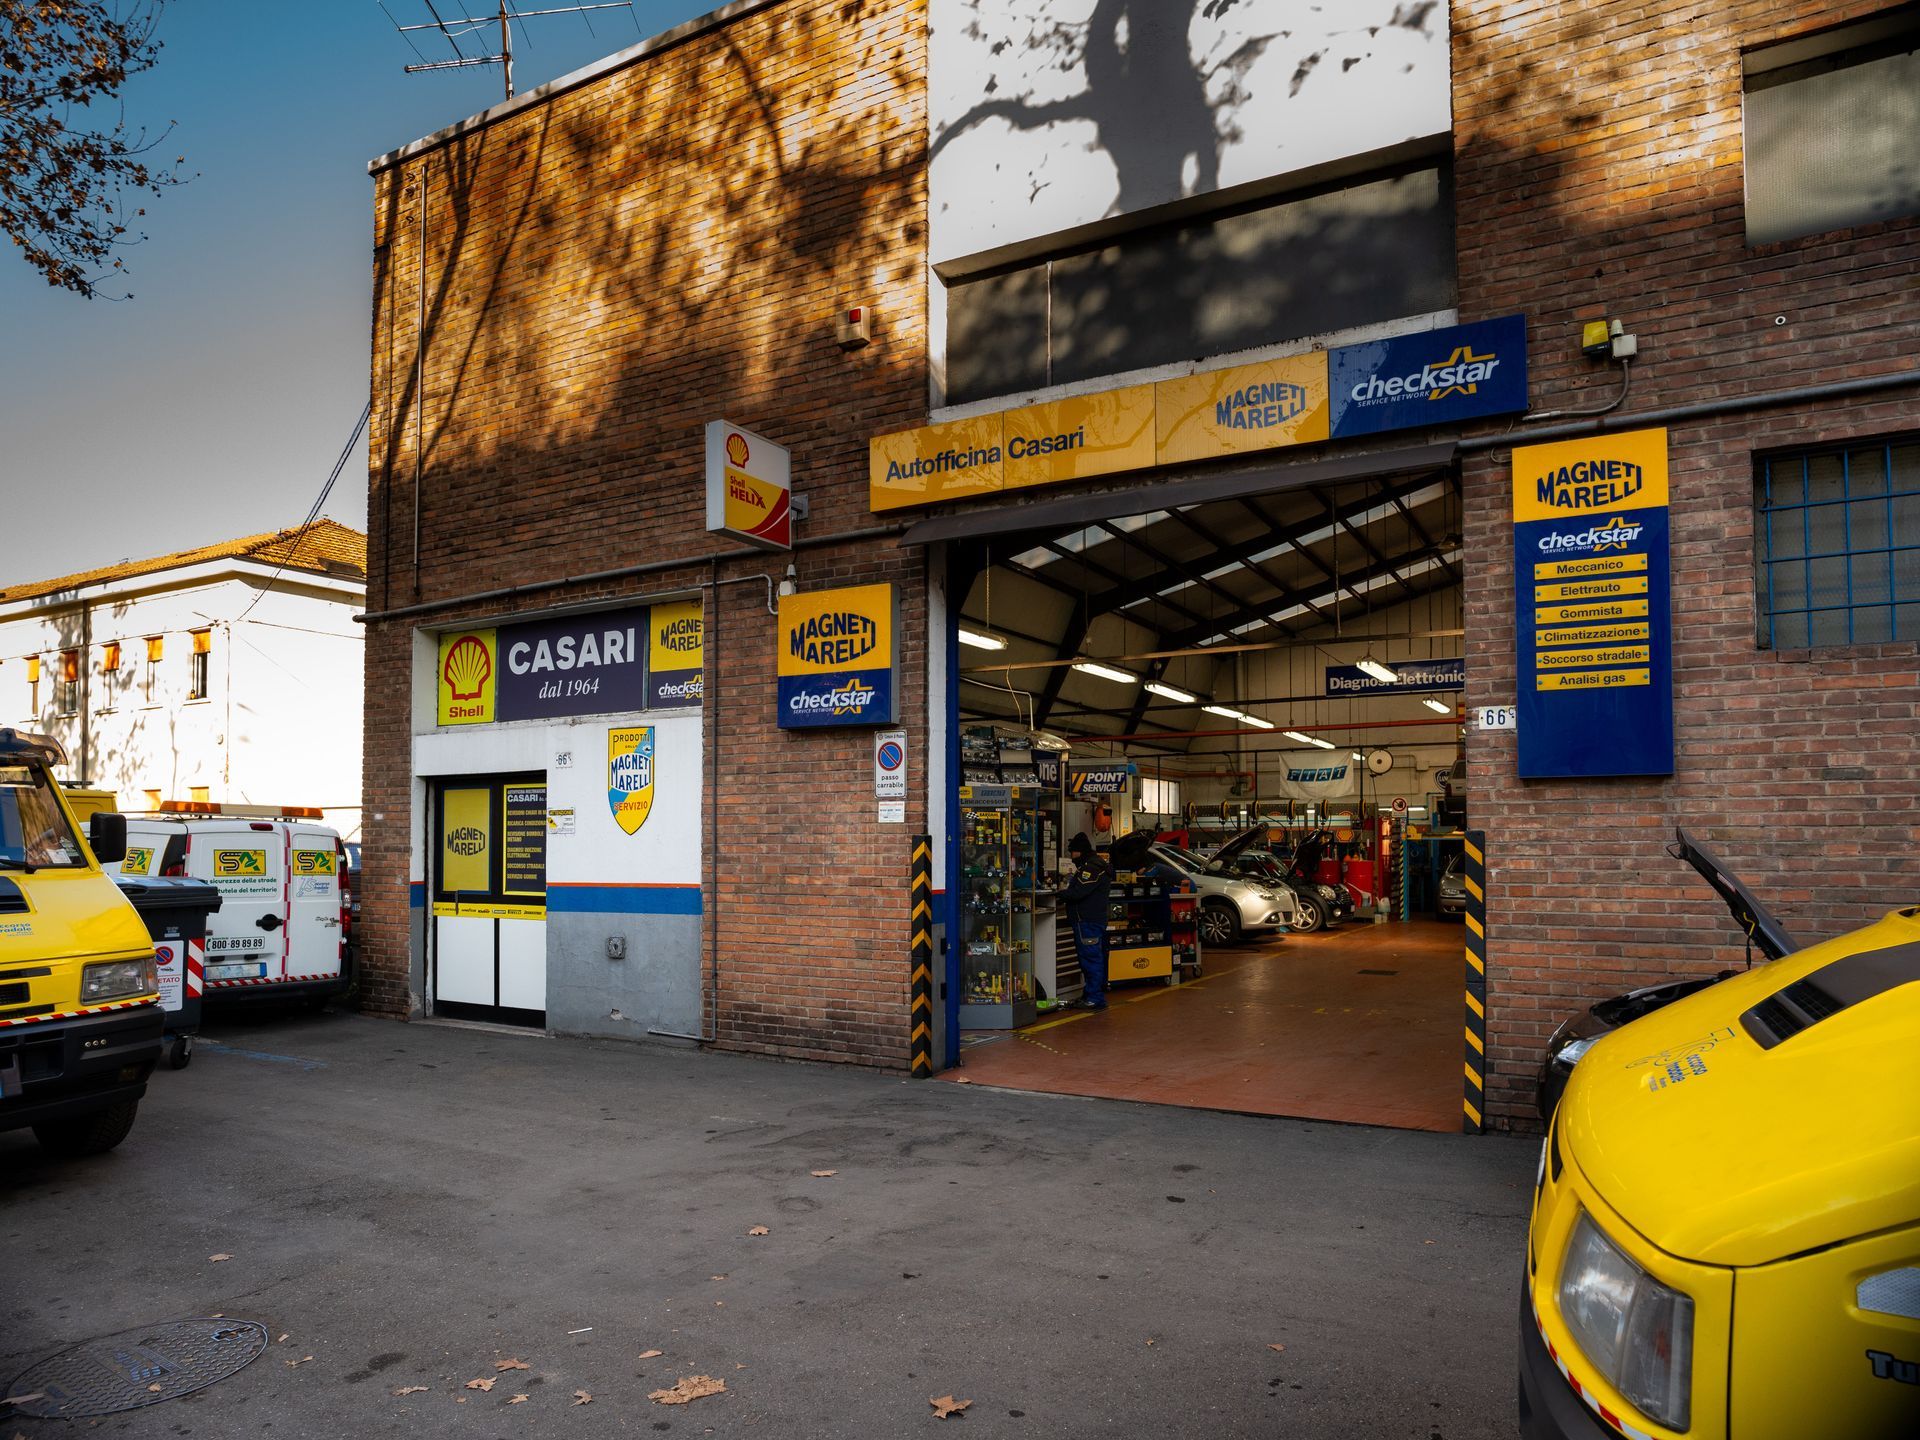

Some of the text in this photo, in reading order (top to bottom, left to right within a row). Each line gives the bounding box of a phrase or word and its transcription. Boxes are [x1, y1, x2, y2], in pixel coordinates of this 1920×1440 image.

[1351, 360, 1500, 401] checkstar
[1216, 383, 1306, 411] MAGNETI
[1357, 390, 1430, 408] SERVICE NETWORK
[1216, 400, 1306, 429] MARELLI
[885, 426, 1084, 482] Autofficina Casari
[730, 475, 746, 489] Shell
[1537, 460, 1642, 489] MAGNETI
[730, 486, 767, 509] HELIX
[1537, 479, 1642, 508] MARELLI
[1538, 527, 1643, 550] checkstar
[1543, 544, 1595, 555] SERVICE NETWORK
[1556, 560, 1624, 575] Meccanico
[1560, 583, 1621, 596] Elettrauto
[1560, 606, 1623, 619] Gommista
[790, 612, 876, 641] MAGNETI
[1544, 628, 1641, 642] Climatizzazione
[508, 628, 635, 675] CASARI
[790, 634, 876, 665] MARELLI
[1543, 650, 1642, 665] Soccorso stradale
[1330, 676, 1390, 691] Diagnos
[1559, 674, 1626, 686] Analisi gas
[538, 678, 600, 700] dal 1964
[790, 688, 876, 710] checkstar
[448, 705, 485, 718] Shell
[613, 733, 650, 750] PRODOTTI
[1086, 772, 1125, 782] POINT
[1288, 765, 1348, 782] FIAT
[1082, 783, 1118, 792] SERVICE
[507, 794, 538, 802] CASARI
[614, 800, 648, 811] SERVIZIO
[447, 827, 486, 845] MAGNETI
[447, 838, 486, 856] MARELLI
